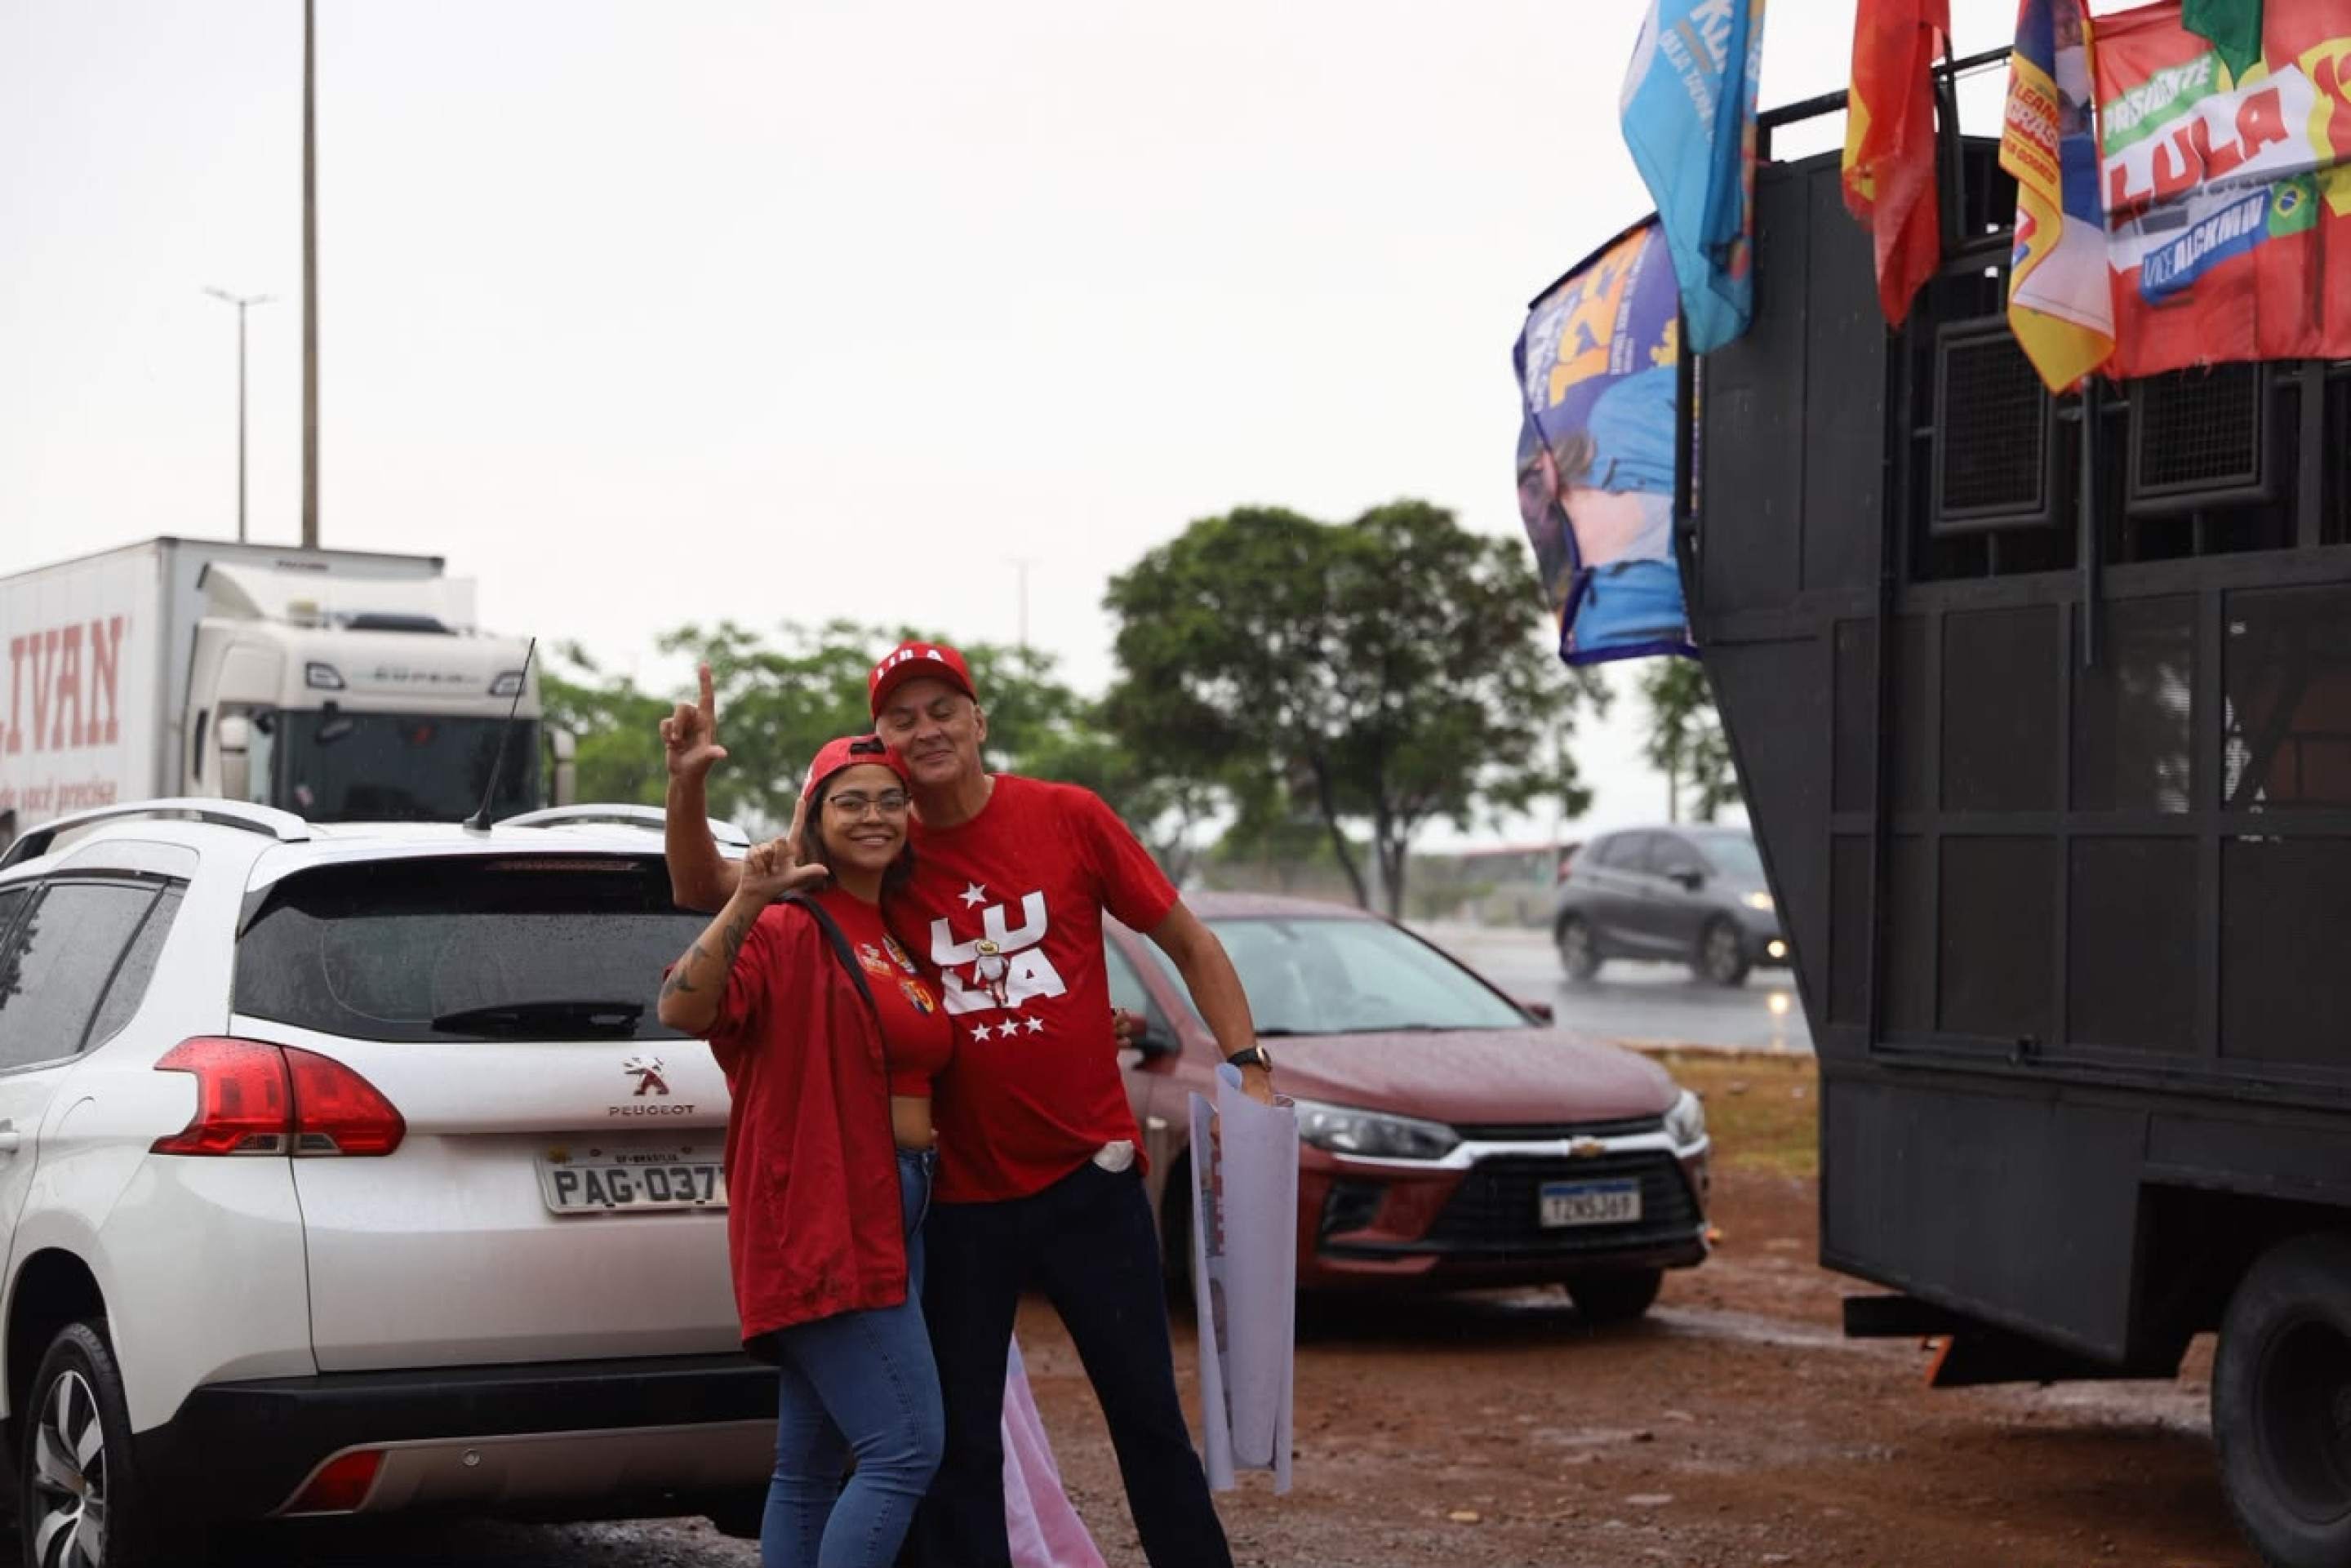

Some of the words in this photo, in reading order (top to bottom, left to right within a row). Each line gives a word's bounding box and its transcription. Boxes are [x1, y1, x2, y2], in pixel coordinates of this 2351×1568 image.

[2109, 87, 2288, 233] LULA
[0, 615, 123, 754] IVAN
[609, 1105, 695, 1117] PEUGEOT
